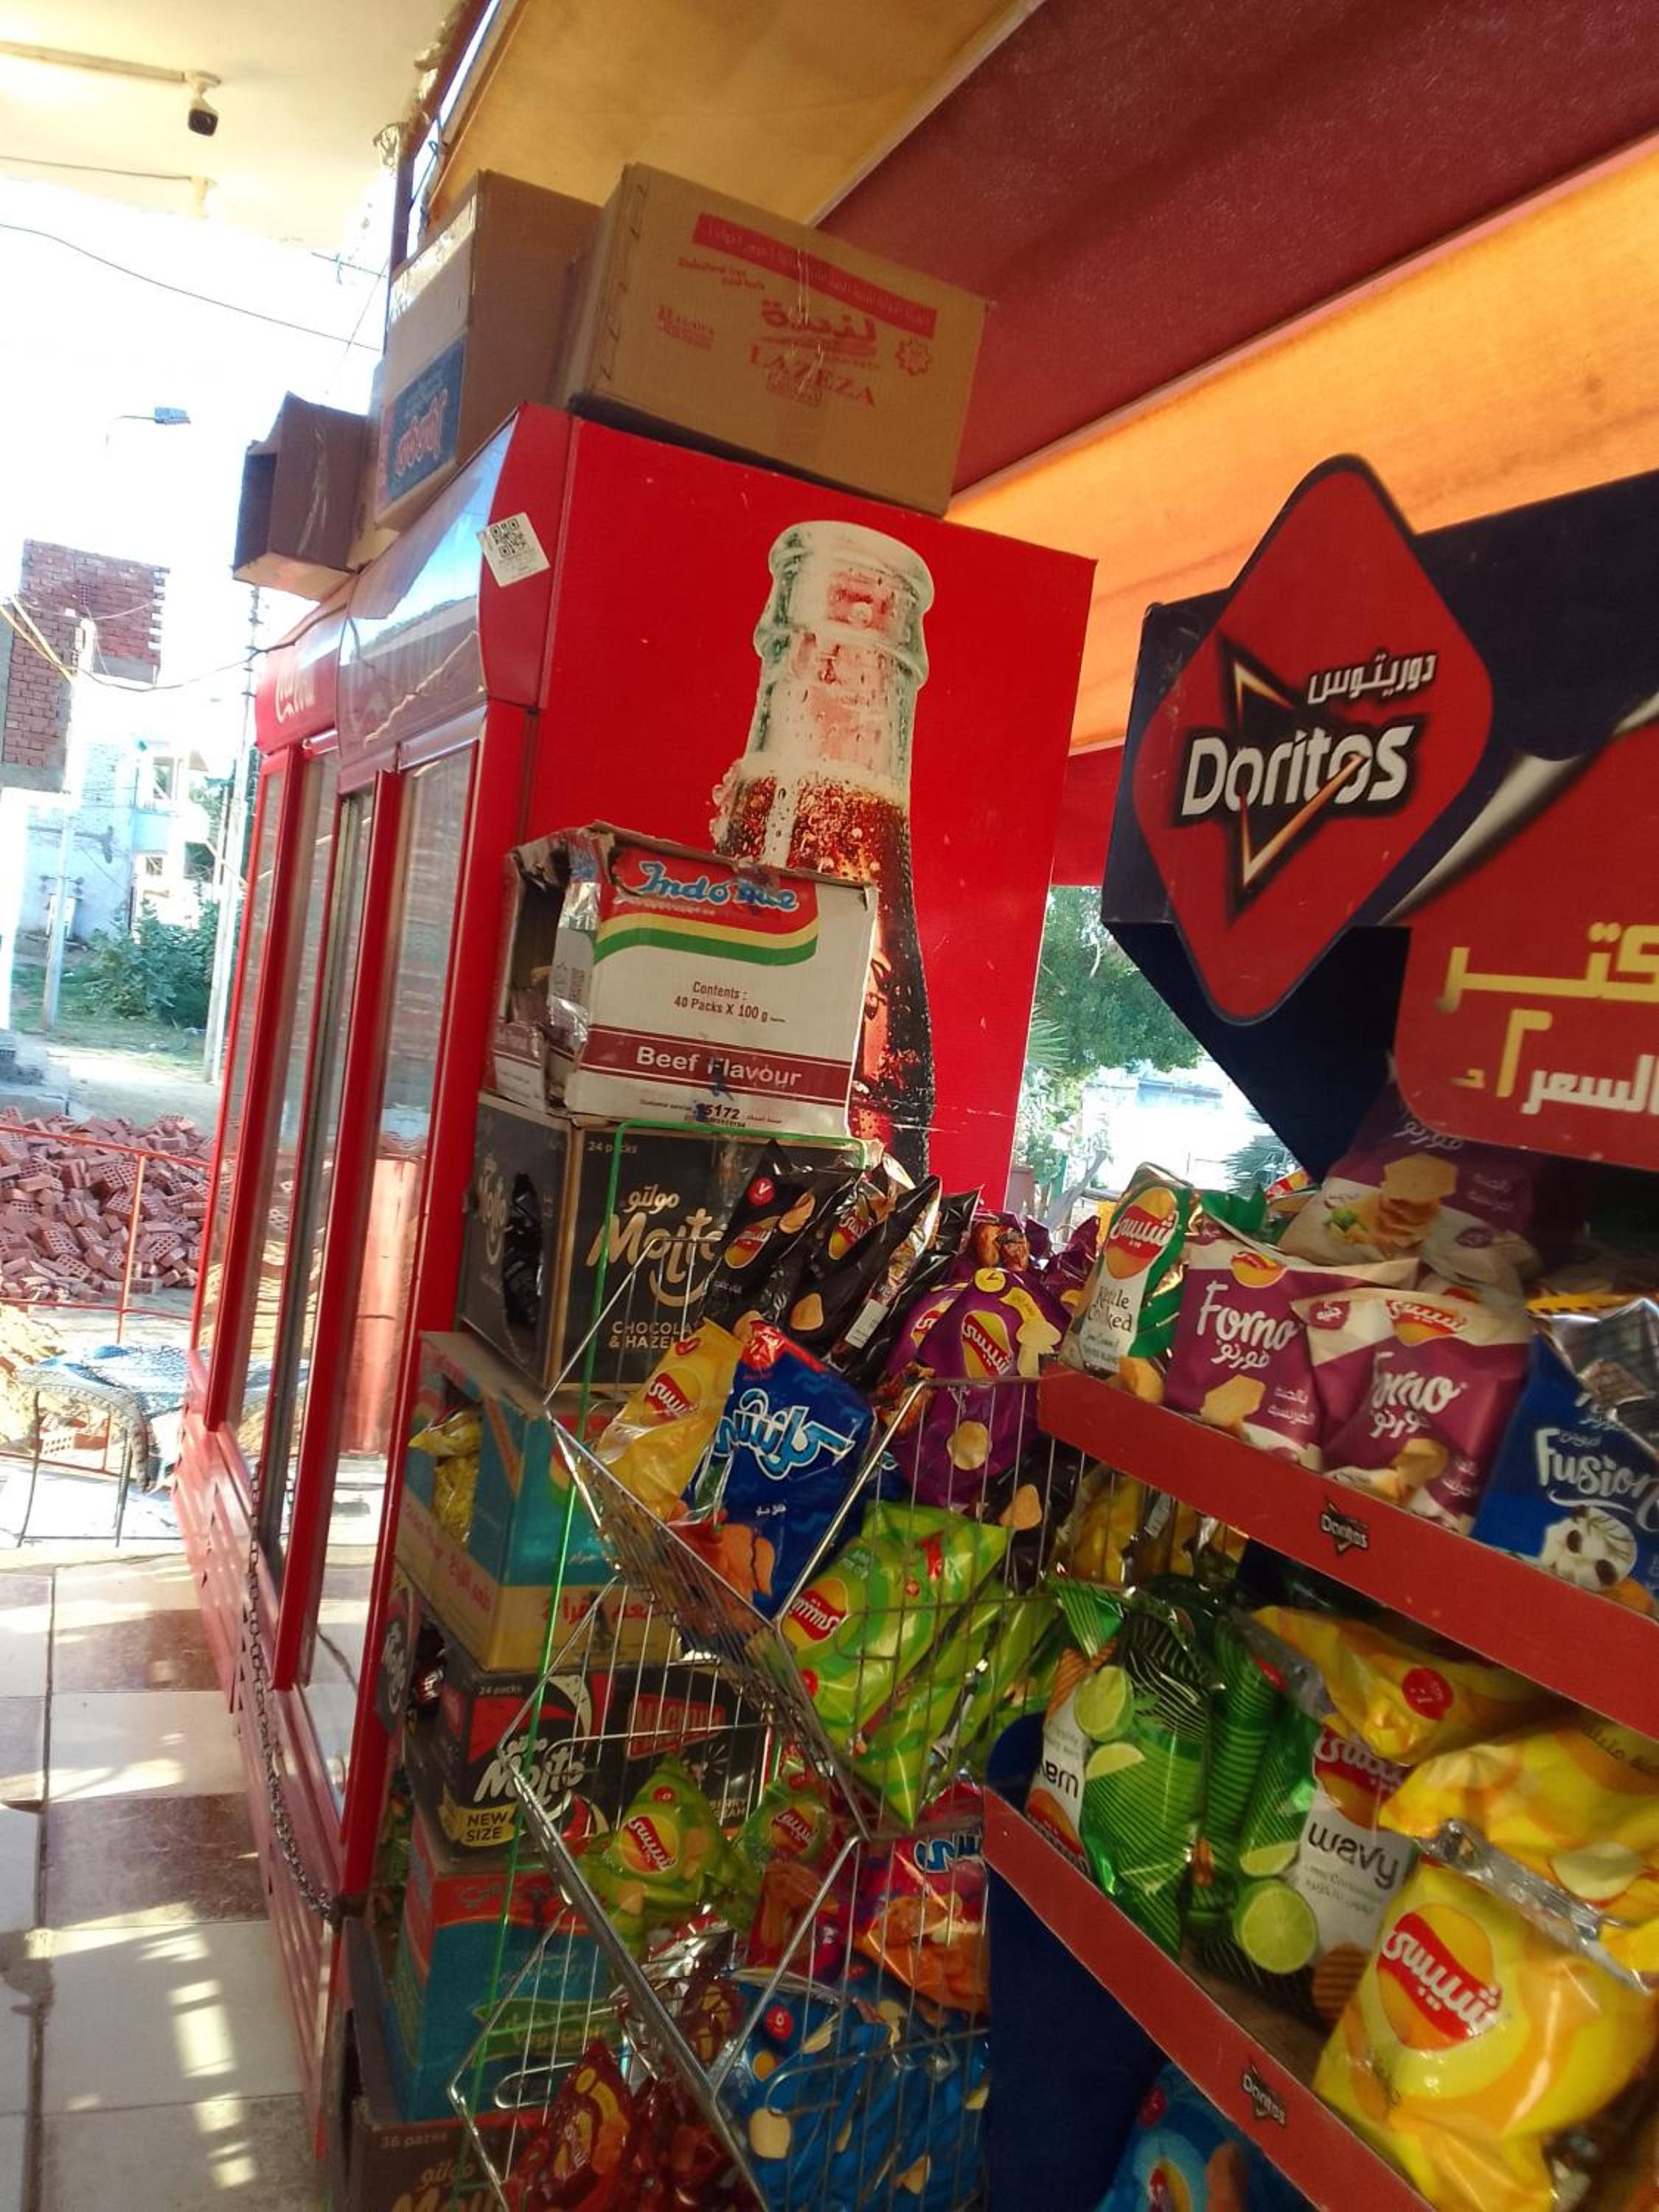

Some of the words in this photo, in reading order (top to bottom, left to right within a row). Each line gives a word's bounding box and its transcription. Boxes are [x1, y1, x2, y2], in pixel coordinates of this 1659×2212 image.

[750, 345, 876, 408] LAZEZA
[1306, 648, 1437, 706] دوريتوس
[1181, 724, 1415, 817] Doritos
[693, 981, 740, 1000] Contents
[674, 995, 688, 1008] 40
[691, 998, 723, 1014] Packs
[738, 1004, 759, 1019] 100
[636, 1045, 700, 1071] Beef
[589, 1141, 603, 1152] 24
[623, 1184, 681, 1215] مولتو
[612, 1321, 694, 1335] CHOCOLA
[1197, 1280, 1298, 1351] Forno
[609, 1335, 620, 1349] &
[1211, 1338, 1270, 1370] فورنو
[467, 1811, 507, 1828] NEW
[466, 1826, 502, 1843] SIZE
[1307, 1822, 1399, 1890] wavy
